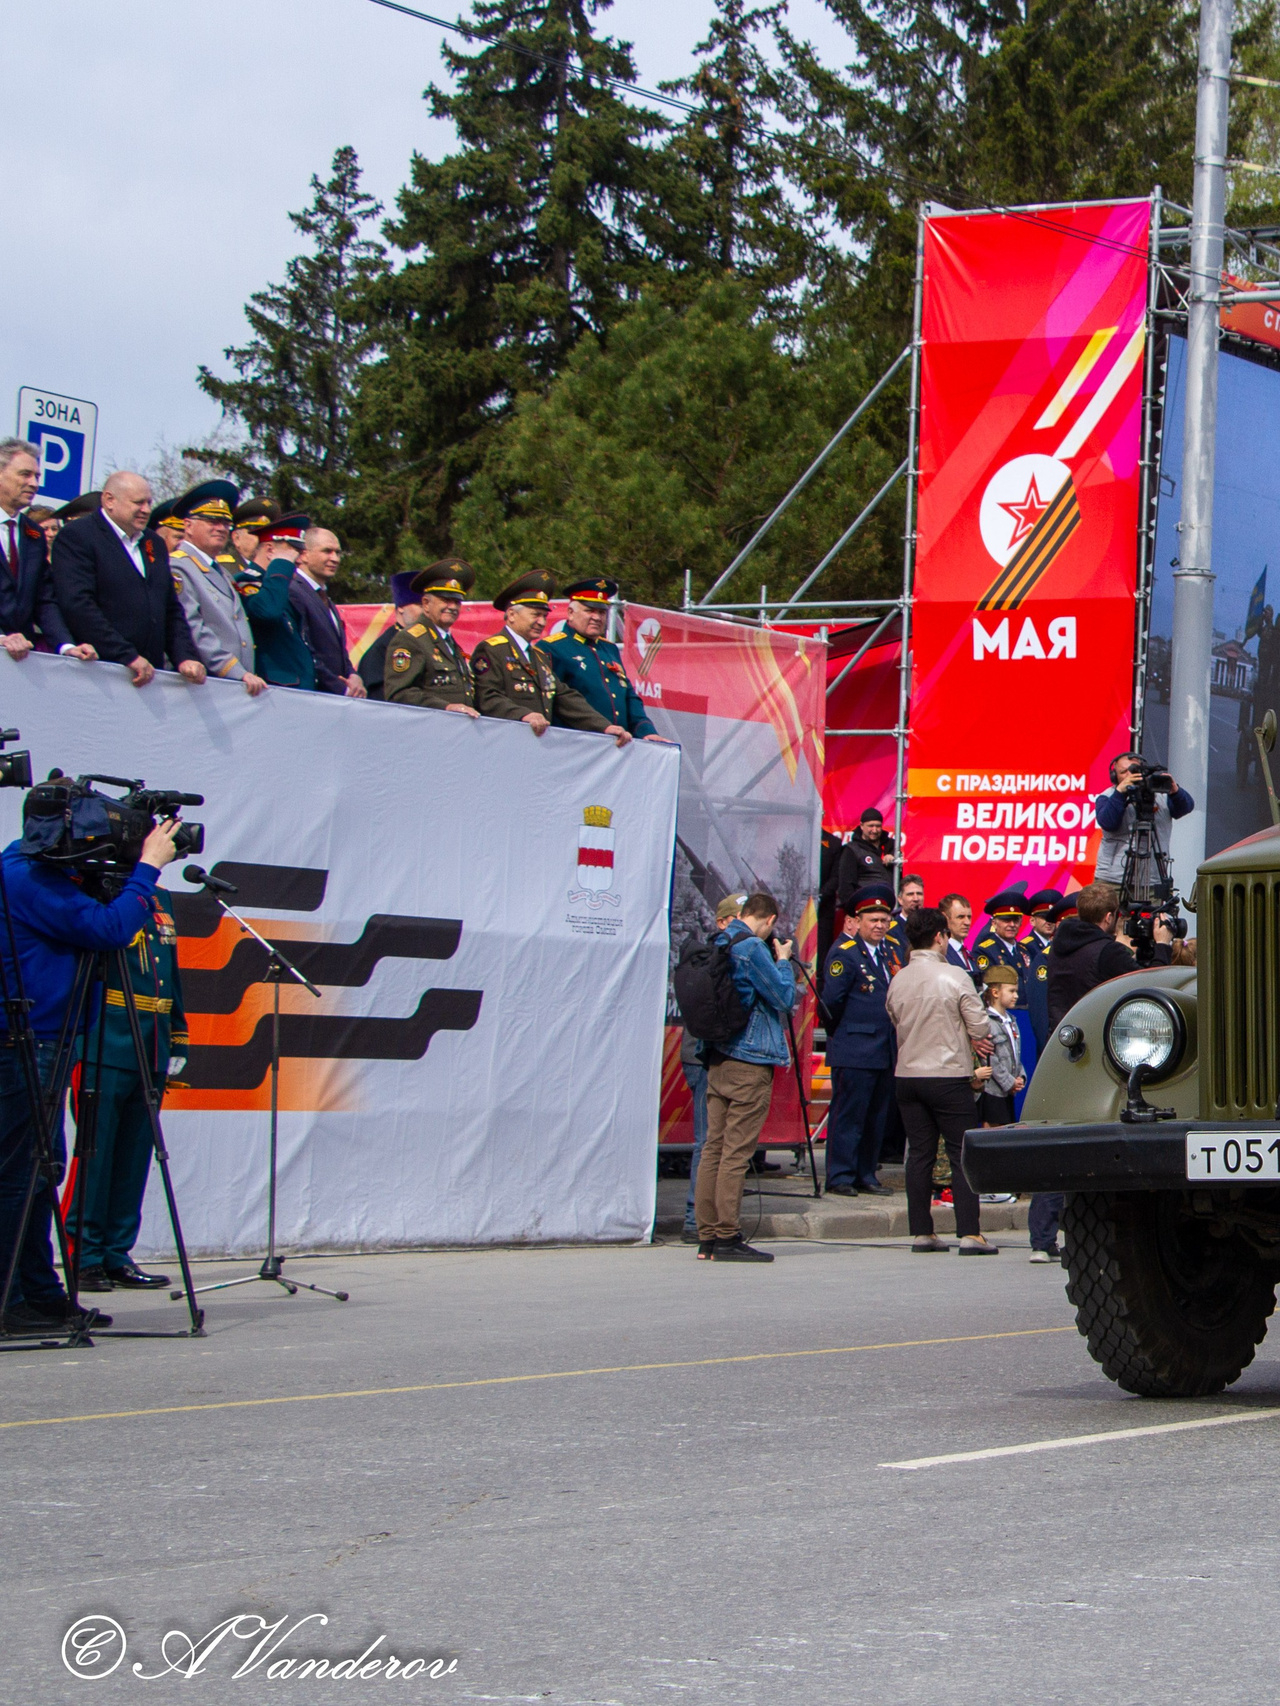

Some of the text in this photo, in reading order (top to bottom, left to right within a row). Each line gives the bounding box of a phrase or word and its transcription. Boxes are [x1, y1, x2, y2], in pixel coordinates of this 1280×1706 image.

[1263, 310, 1274, 329] С
[35, 399, 81, 425] ЗОНА
[38, 432, 70, 488] P
[972, 616, 1077, 661] МАЯ
[635, 679, 662, 699] МАЯ
[937, 774, 1086, 794] С ПРАЗДНИКОМ
[957, 794, 1100, 829] ВЕЛИКОЙ
[940, 836, 1088, 866] ПОБЕДЫ!
